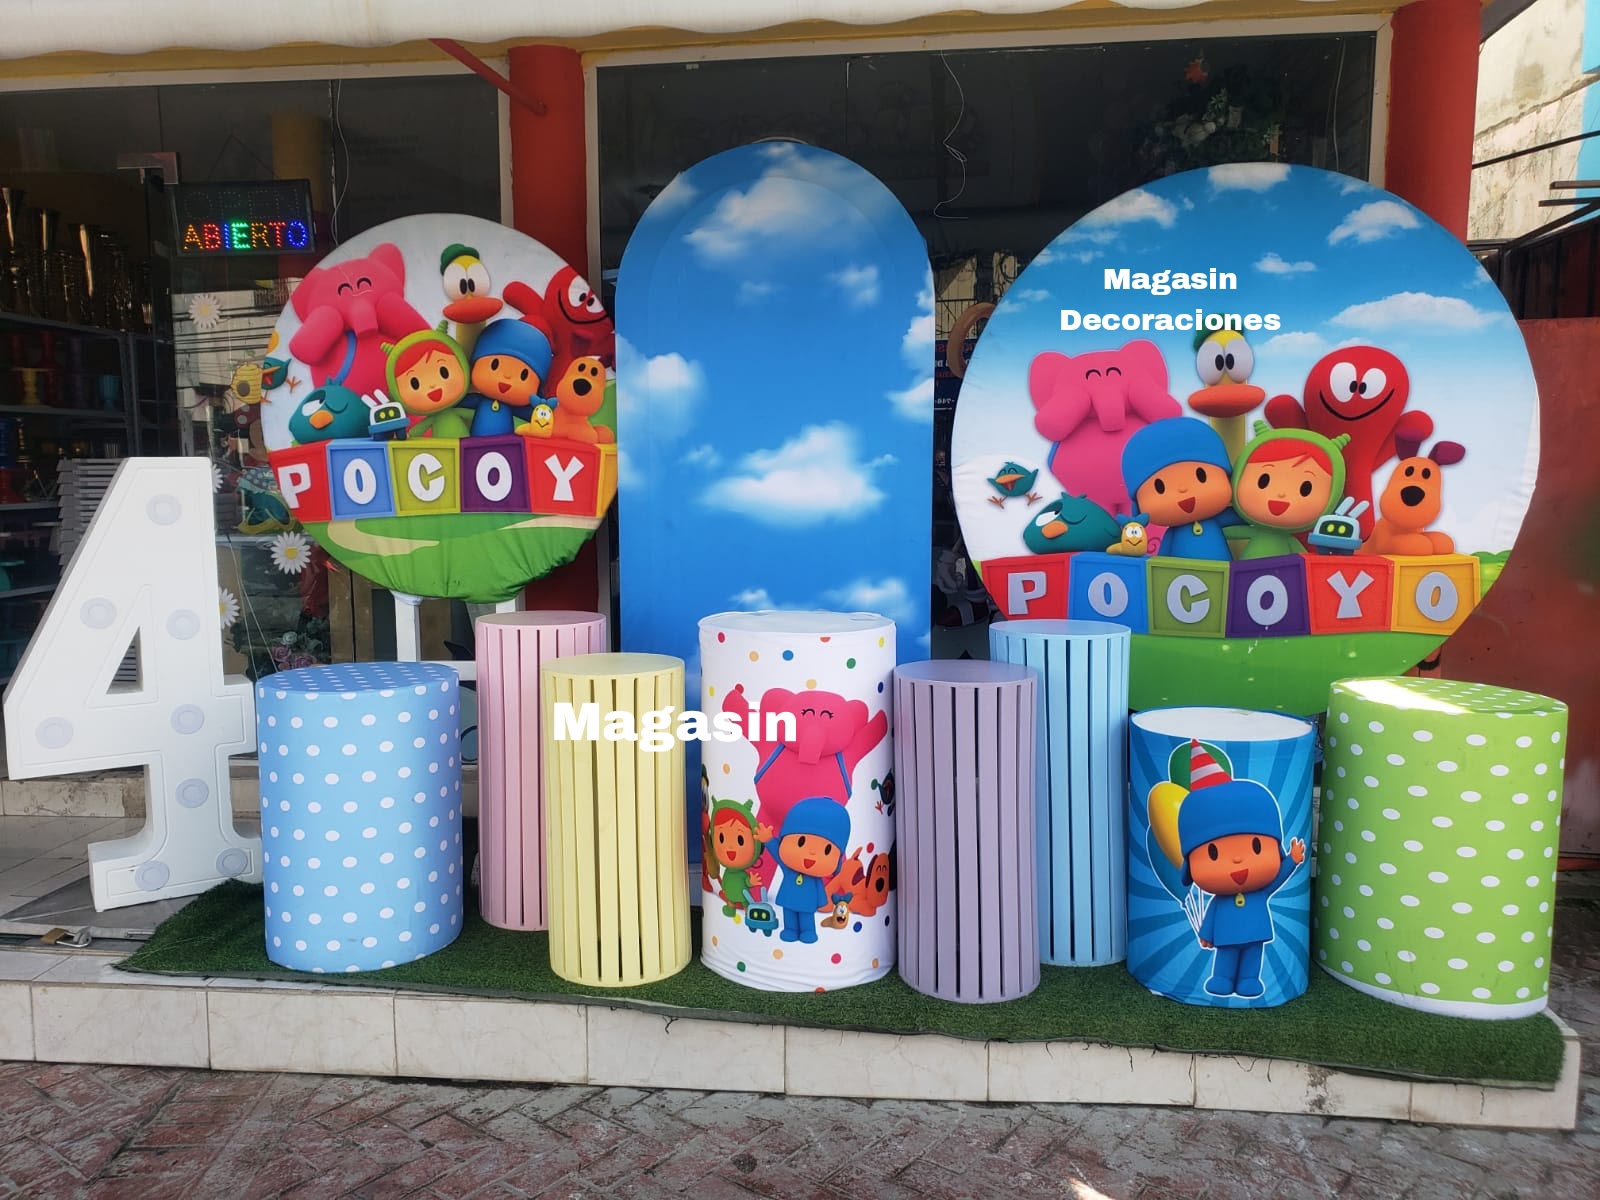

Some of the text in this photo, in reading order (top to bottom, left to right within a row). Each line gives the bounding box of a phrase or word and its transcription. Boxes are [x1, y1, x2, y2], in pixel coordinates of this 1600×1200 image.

[183, 221, 308, 249] ABIERTO
[277, 451, 585, 509] POCOY
[1007, 570, 1459, 626] POCOYO
